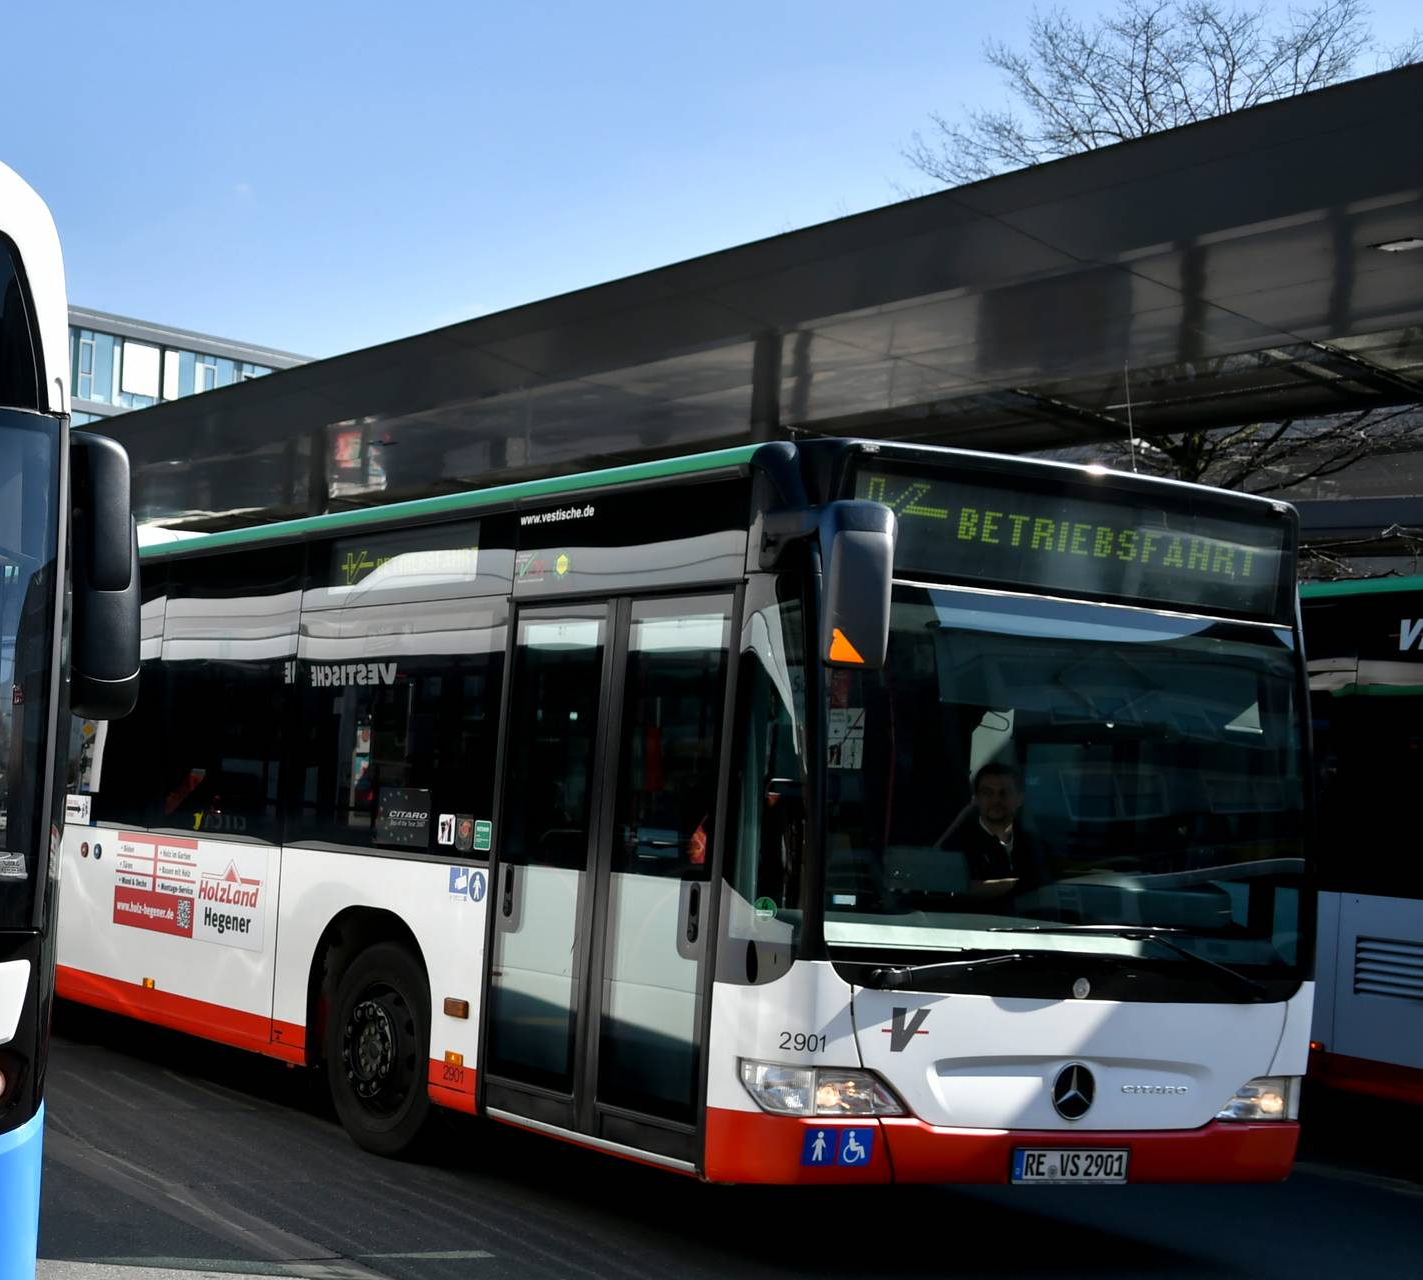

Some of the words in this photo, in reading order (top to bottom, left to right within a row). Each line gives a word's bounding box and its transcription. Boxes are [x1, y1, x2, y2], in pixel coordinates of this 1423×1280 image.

[520, 504, 595, 526] www.vestische.de
[956, 507, 1257, 578] BETRIEBSFAHRT
[388, 810, 428, 819] CITARO
[198, 879, 259, 908] HolzLand
[116, 900, 175, 920] www.holz-hegener.de
[204, 906, 251, 934] Hegener
[779, 1031, 827, 1053] 2901
[442, 1064, 464, 1086] 2901
[1120, 1084, 1189, 1096] CITARO
[1024, 1153, 1047, 1177] RE
[1060, 1153, 1081, 1177] VS
[1083, 1153, 1124, 1177] 2901
